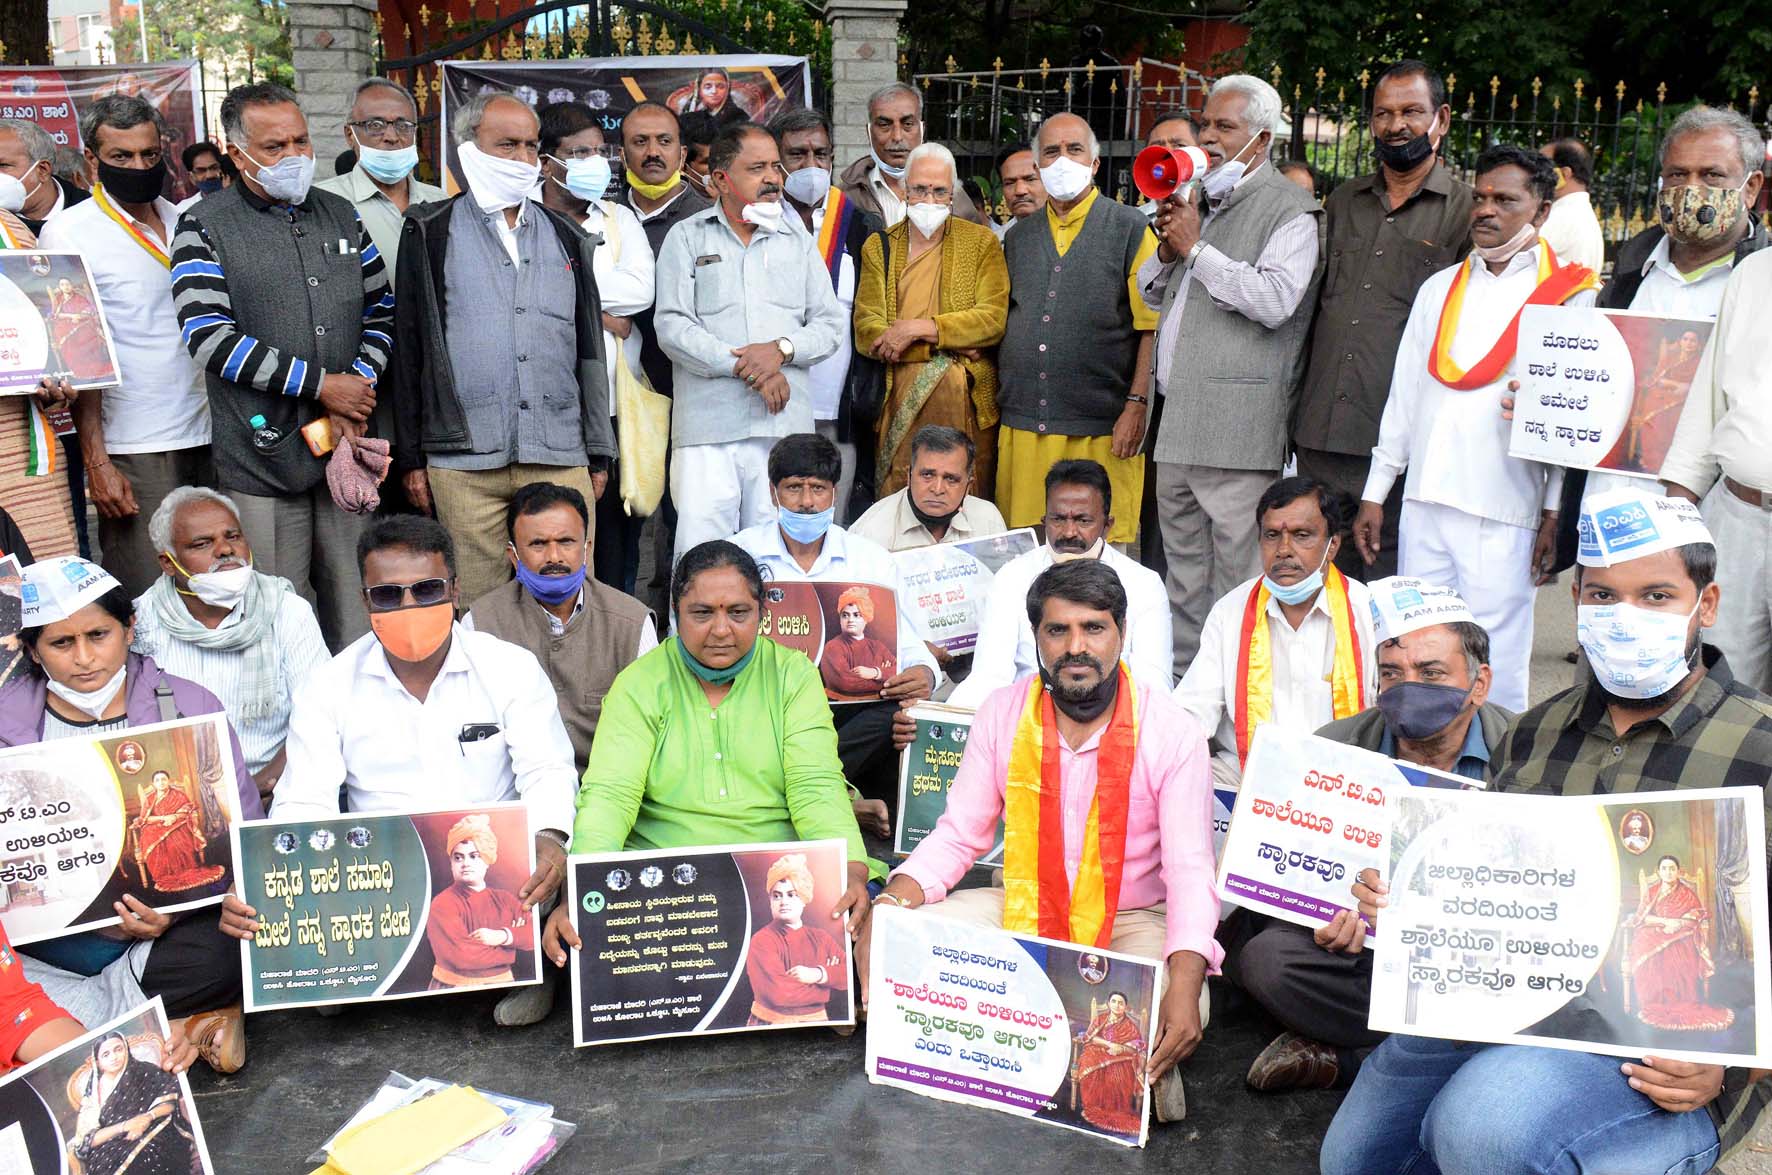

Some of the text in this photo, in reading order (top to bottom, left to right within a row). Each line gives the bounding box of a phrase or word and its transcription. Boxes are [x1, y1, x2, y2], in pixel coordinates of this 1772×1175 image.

[42, 103, 69, 118] ಶಾಲೆ
[49, 130, 69, 145] ರು
[1542, 332, 1600, 351] ಮೊದಲು
[1528, 362, 1610, 382] ಶಾಲೆ ಉಳಿಸಿ
[1525, 421, 1602, 447] ನನ್ನ ಸ್ಮಾರಕ
[77, 576, 100, 592] AAM
[777, 614, 810, 635] ಉಳಿಸಿ
[1404, 607, 1433, 620] AAM
[913, 771, 941, 796] ಪ್ರಥಮ
[1304, 769, 1385, 807] ಎನ್.ಟಿ.ಎ
[1251, 798, 1334, 834] ಶಾಲೆಯೂ
[6, 827, 95, 852] ಉಳಿಯಲಿ.
[57, 851, 106, 871] ಆಗಲಿ
[1257, 842, 1346, 882] ಸ್ಮಾರಕವೂ
[264, 856, 395, 910] ಕನ್ನಡ ಶಾಲೆ ಸಮಾಧಿ
[1428, 864, 1576, 889] ಜಿಲ್ಲಾಧಿಕಾರಿಗಳ
[1442, 896, 1559, 921] ವರದಿಯಂತೆ
[255, 901, 411, 957] ಮೇಲೆ ನನ್ನ ಸ್ಮಾರಕ ಬೇಡ
[1400, 928, 1600, 959] ಶಾಲೆಯೂ ಉಳಿಯಲಿ
[932, 945, 1019, 973] ಜಿಲ್ಲಾಧಿಕಾರಿಗಳ
[939, 971, 1007, 995] ವರದಿಯಂತೆ
[1412, 965, 1583, 994] ಸ್ಮಾರಕವೂ ಆಗಲಿ
[915, 1037, 952, 1057] ಎಂದು
